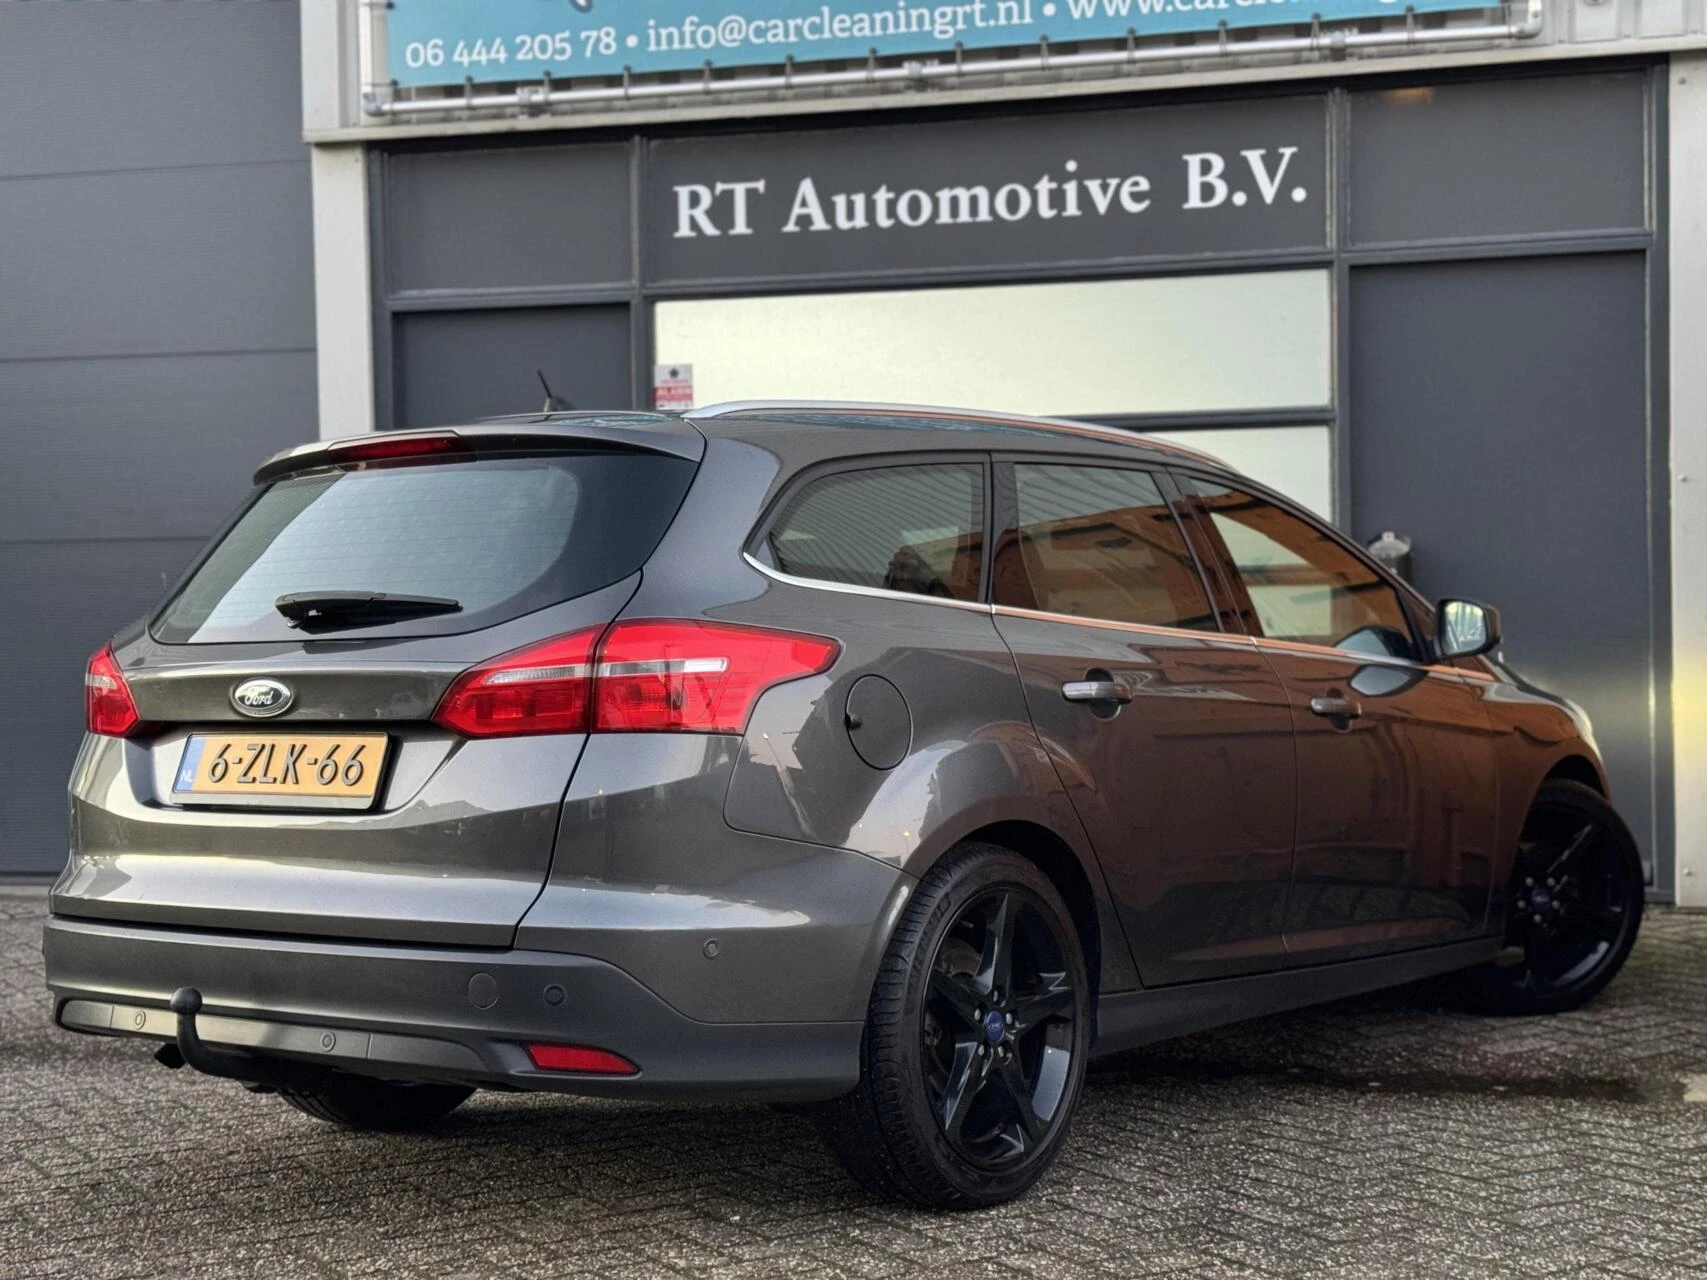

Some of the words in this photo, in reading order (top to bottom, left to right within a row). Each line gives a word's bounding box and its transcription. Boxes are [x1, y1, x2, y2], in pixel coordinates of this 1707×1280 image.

[405, 38, 444, 68] 06
[452, 37, 508, 68] 444
[515, 30, 572, 61] 205
[580, 26, 617, 58] 78
[646, 0, 1033, 52] info@carcleaningrt.nl
[673, 179, 765, 238] RT
[782, 160, 1151, 233] Automotive
[1182, 147, 1308, 211] B.V.
[208, 743, 366, 787] 6-ZLK-66
